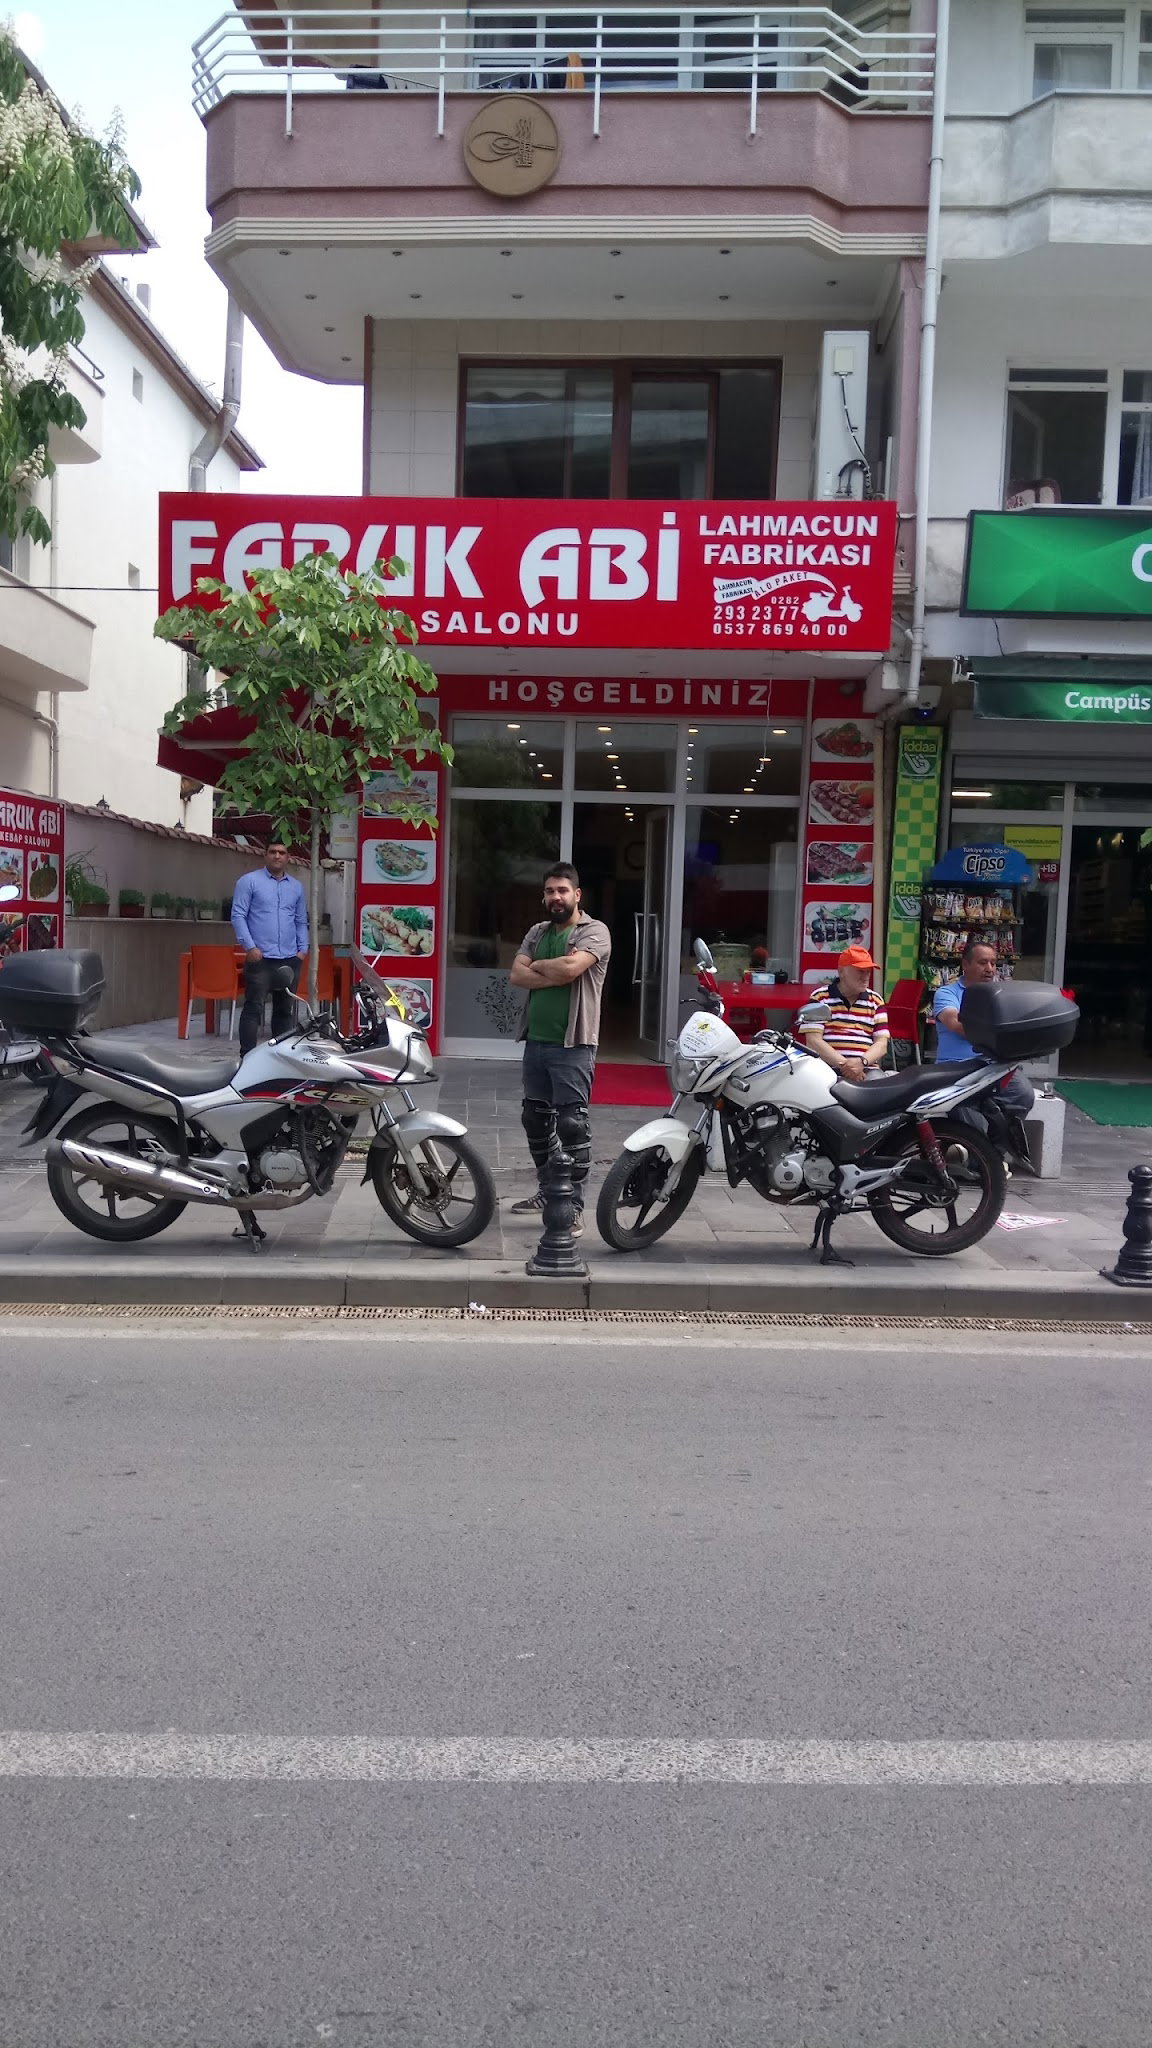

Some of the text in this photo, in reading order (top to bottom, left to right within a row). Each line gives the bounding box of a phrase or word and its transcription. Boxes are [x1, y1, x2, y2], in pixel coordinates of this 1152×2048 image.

[699, 515, 878, 537] LAHMACUN
[172, 511, 680, 608] FARUK ABİ
[704, 539, 871, 566] FABRİKASI
[718, 579, 753, 591] LAHMACUN
[754, 571, 808, 598] ALO PAKET
[771, 596, 800, 605] 0282
[713, 605, 800, 621] 293 23 77
[421, 610, 579, 636] SALONU
[713, 623, 848, 636] 0537 869 40 00
[488, 679, 769, 708] HOŞGELDİNİZ
[1064, 692, 1152, 713] Campüs
[903, 740, 937, 752] iddaa
[39, 807, 60, 836] ABİ
[24, 835, 51, 848] SALONU
[965, 855, 1006, 876] Cipso
[1040, 864, 1057, 873] +18
[895, 882, 922, 895] idda
[302, 1057, 330, 1066] HONDA
